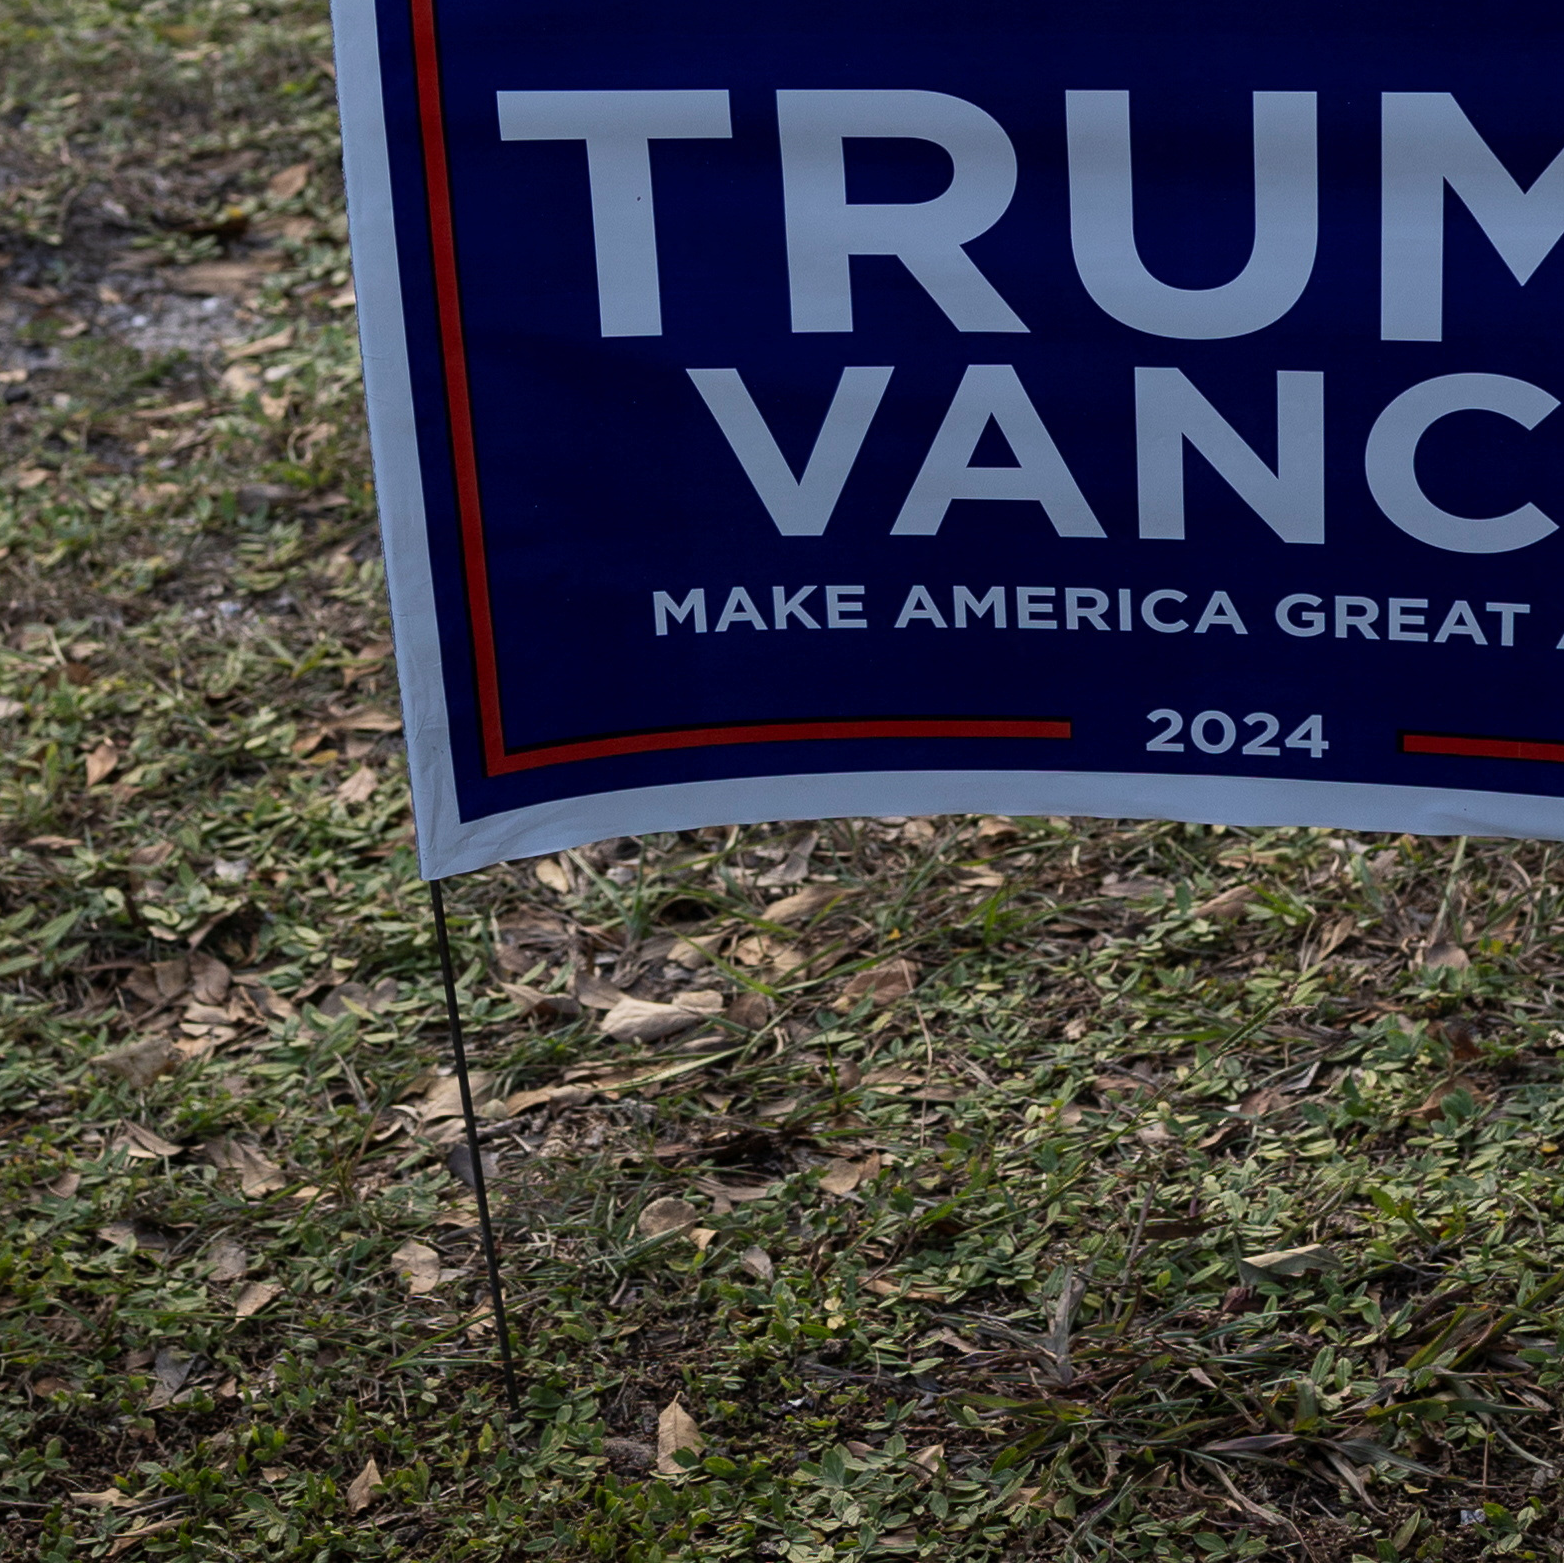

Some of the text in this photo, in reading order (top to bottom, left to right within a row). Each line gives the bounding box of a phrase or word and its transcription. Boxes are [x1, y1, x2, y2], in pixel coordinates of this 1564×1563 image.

[652, 585, 868, 636] MAKE
[893, 585, 1249, 635] AMERICA
[1275, 593, 1531, 647] GREAT
[1145, 708, 1329, 758] 2024
